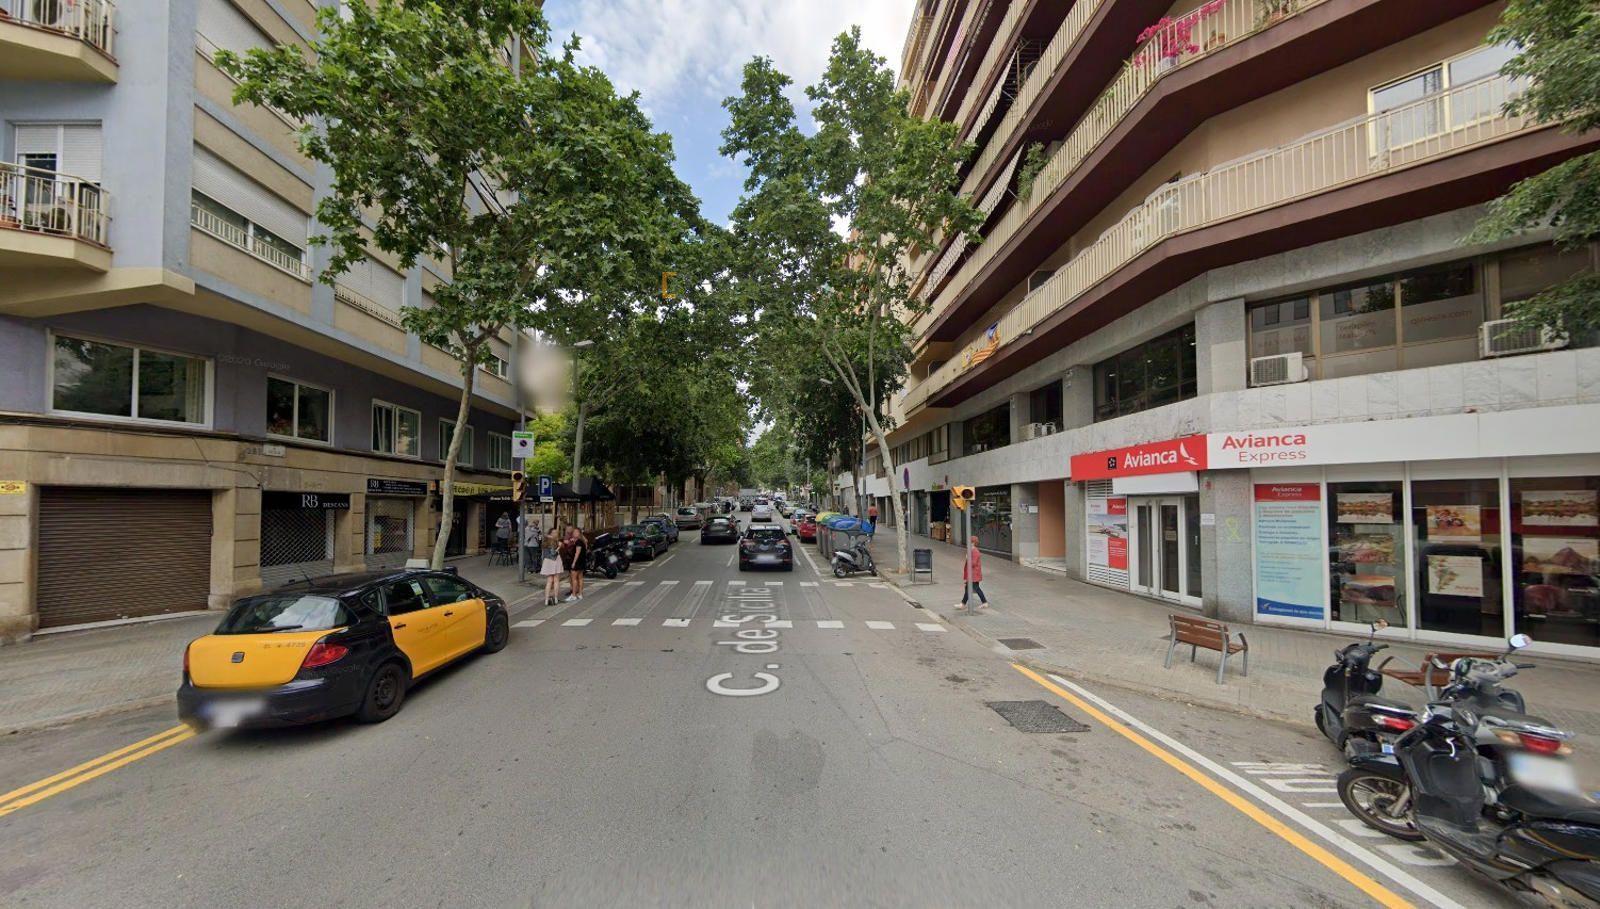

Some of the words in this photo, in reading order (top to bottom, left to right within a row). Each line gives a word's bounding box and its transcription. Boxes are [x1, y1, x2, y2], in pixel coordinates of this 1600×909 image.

[1222, 434, 1306, 449] Avianca
[1123, 450, 1178, 468] Avianca
[1239, 450, 1307, 464] Express
[541, 477, 549, 493] P
[302, 494, 319, 508] RB
